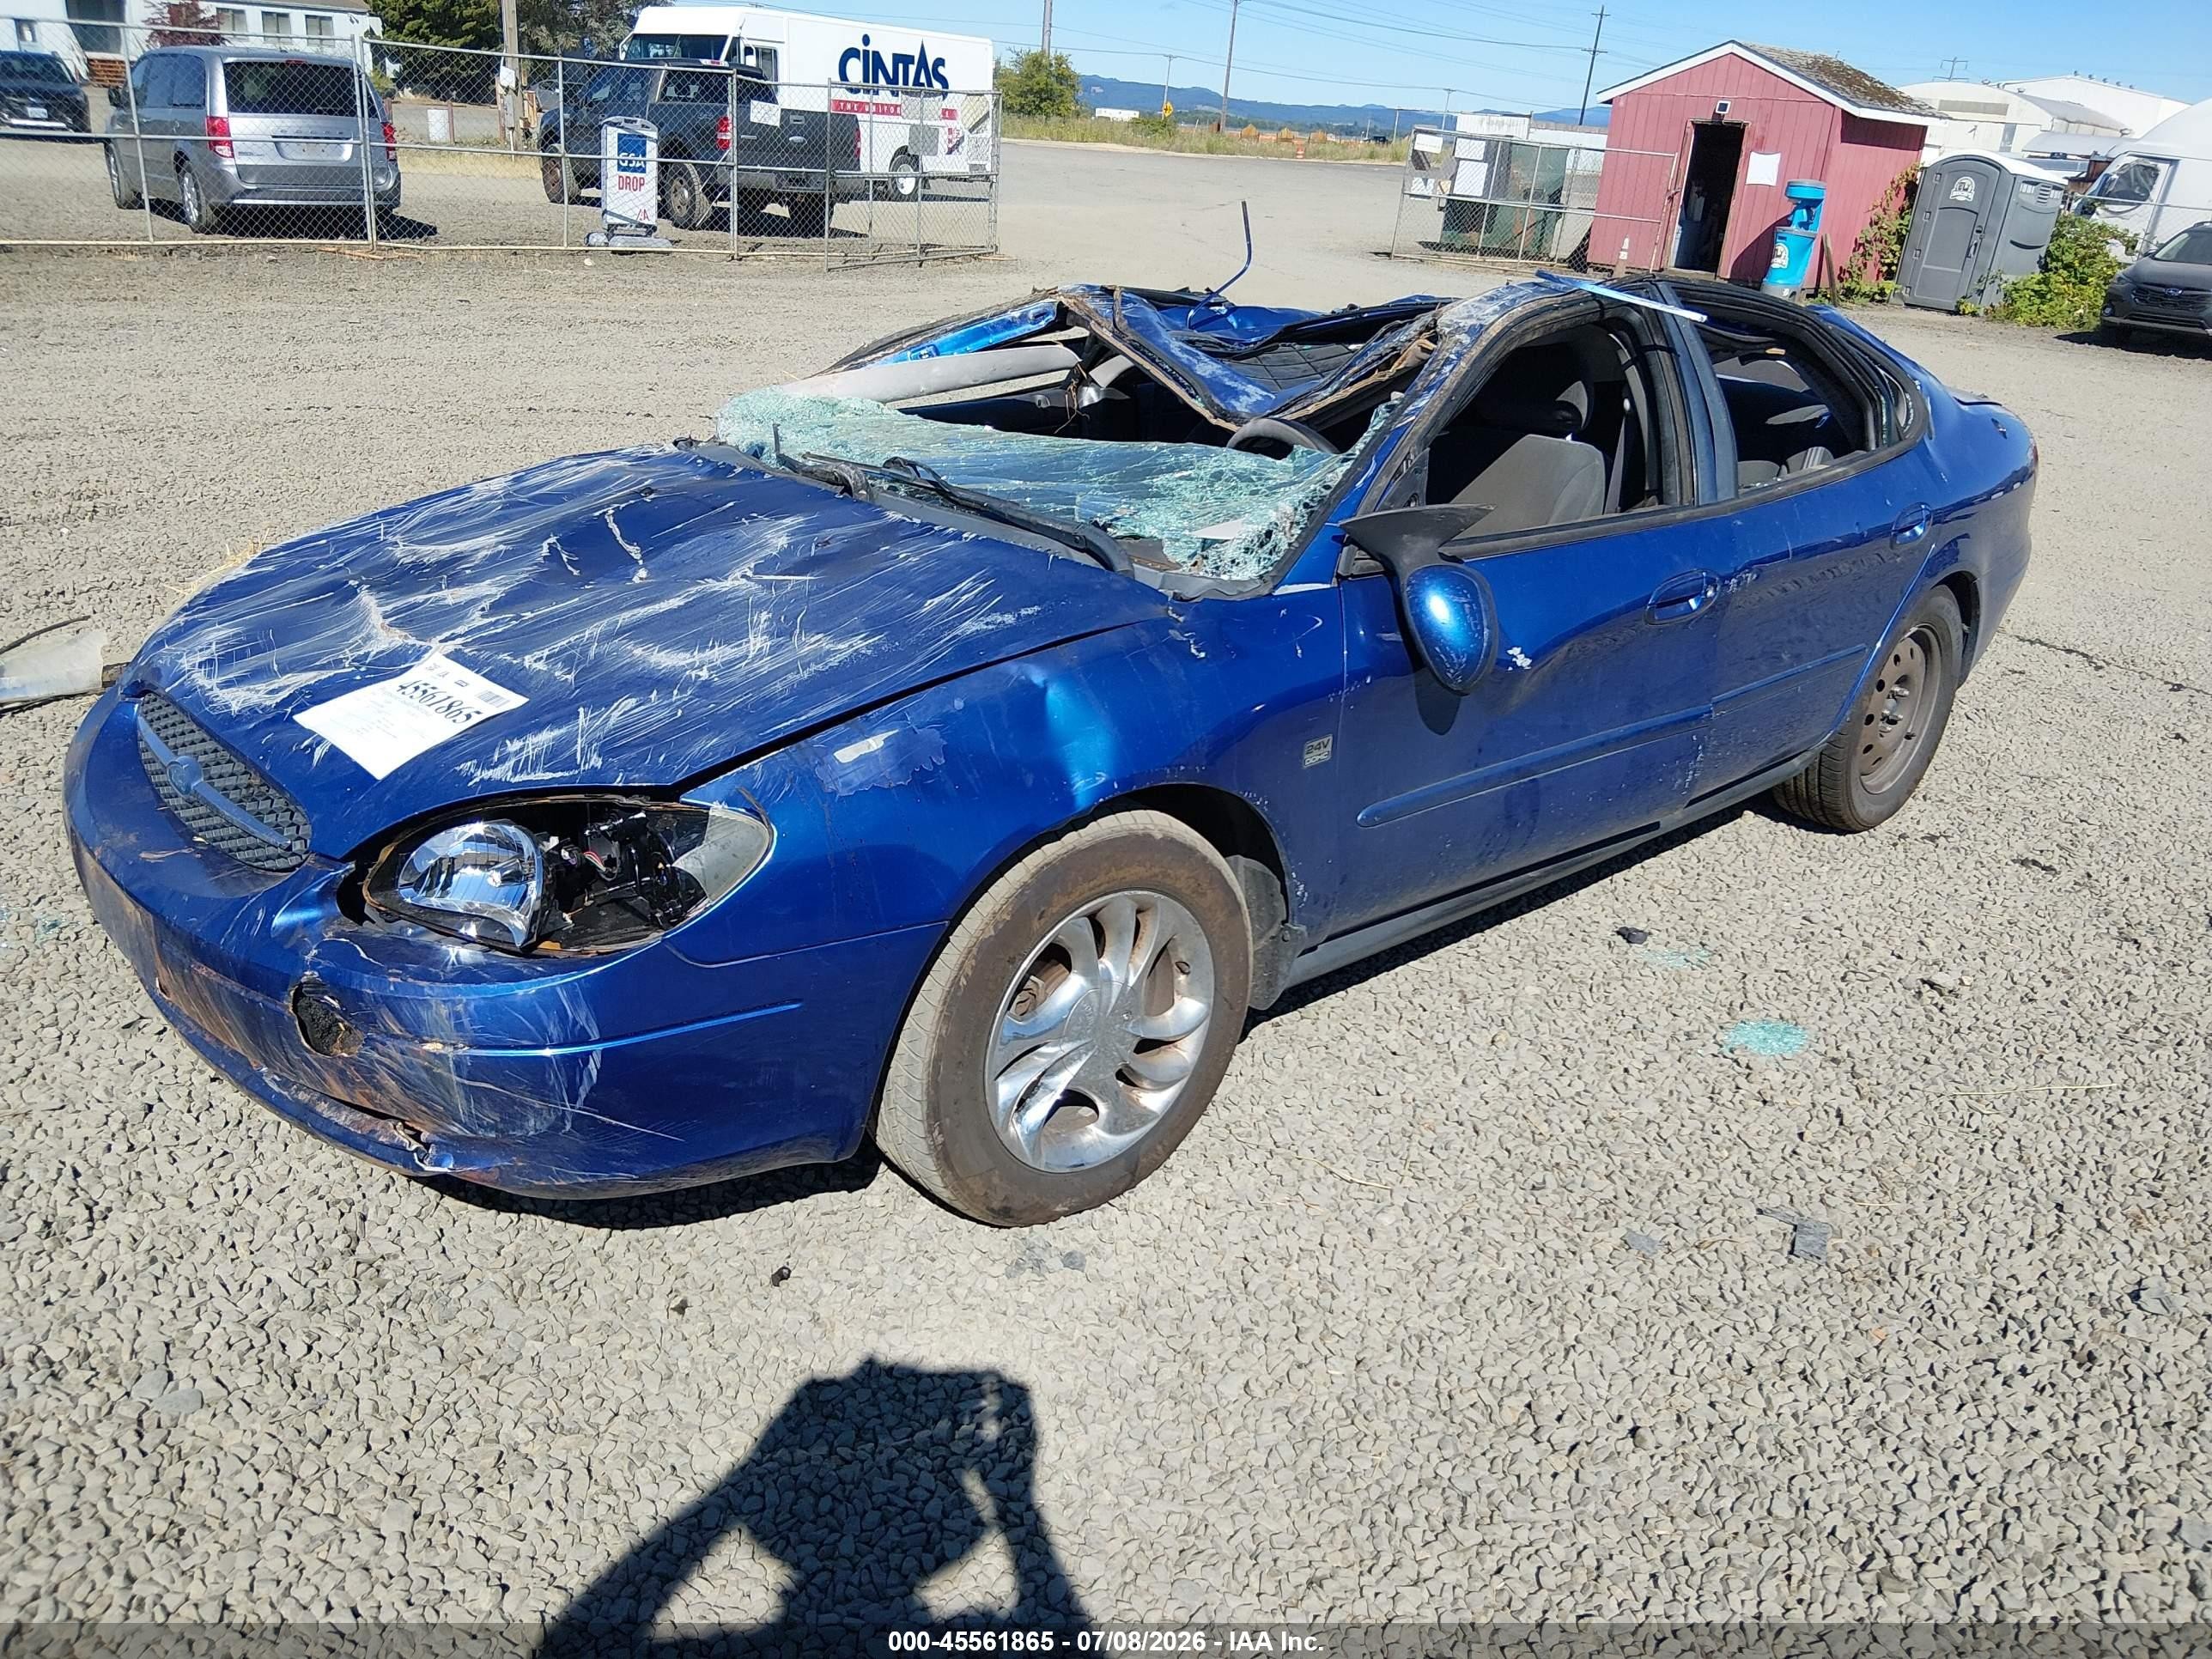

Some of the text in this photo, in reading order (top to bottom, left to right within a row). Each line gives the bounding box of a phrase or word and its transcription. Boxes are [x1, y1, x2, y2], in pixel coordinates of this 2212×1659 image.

[618, 152, 646, 168] GSA
[617, 175, 646, 192] DROP
[397, 679, 483, 724] 45561865
[1305, 738, 1331, 755] 24V
